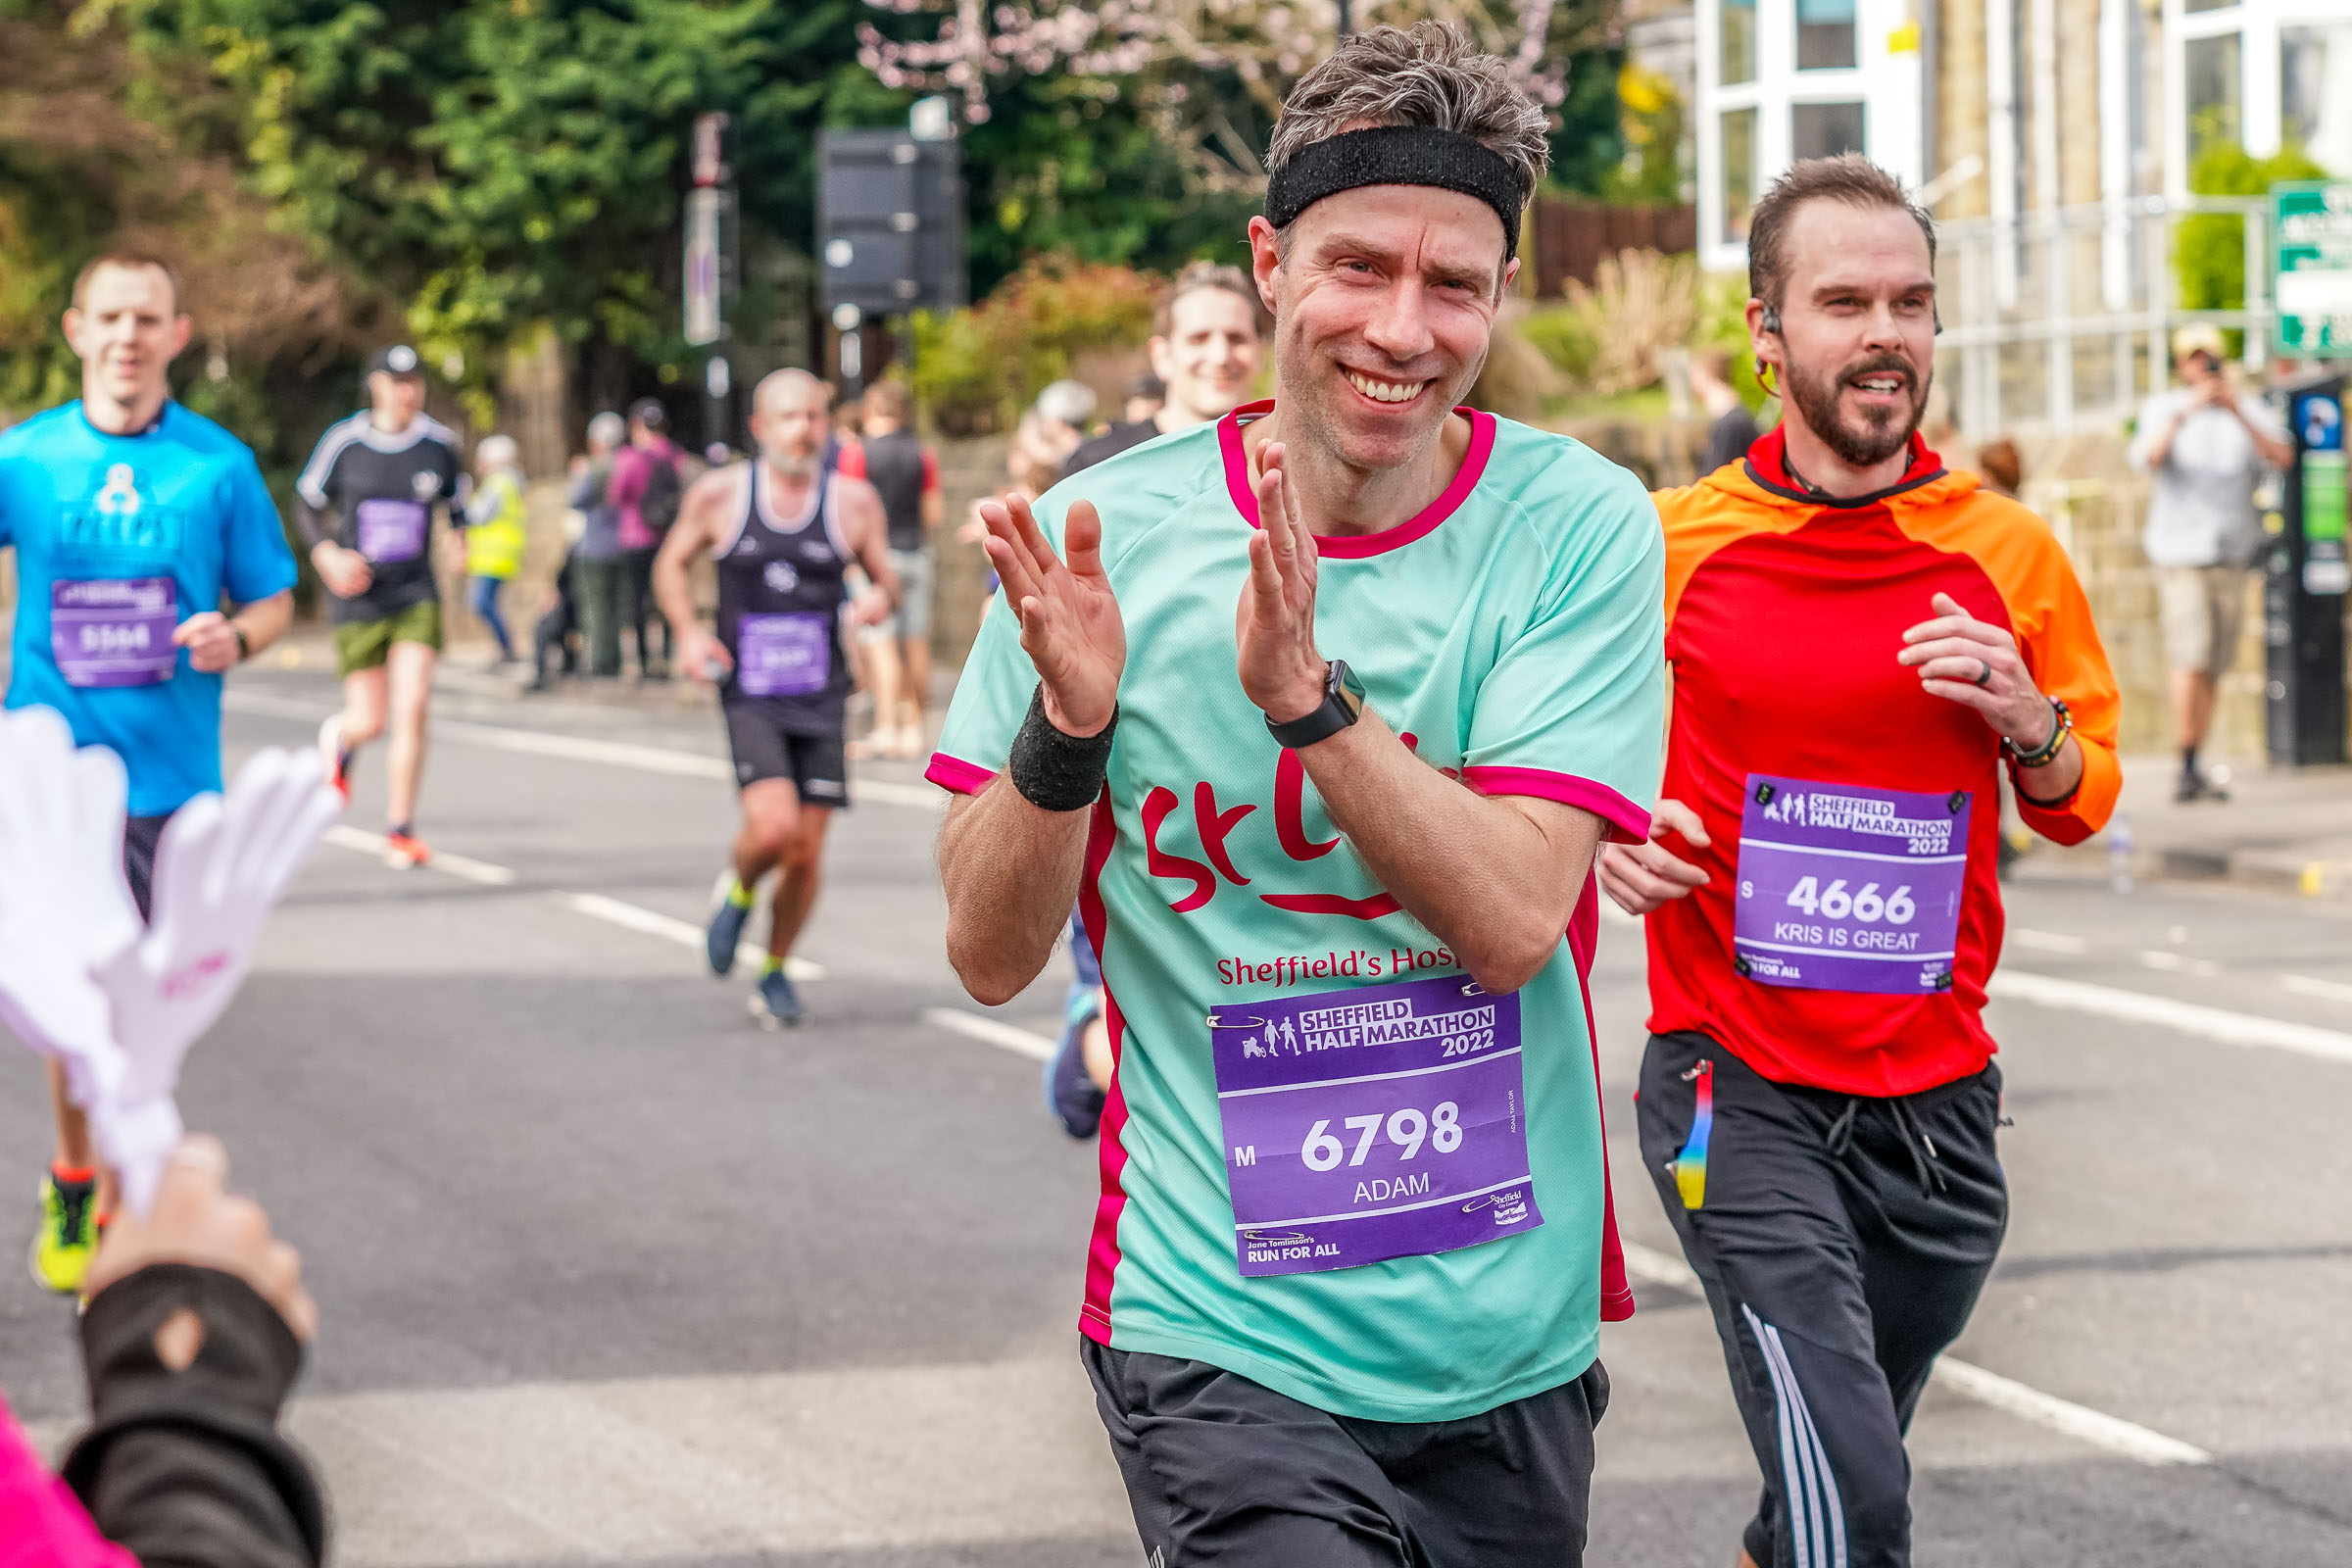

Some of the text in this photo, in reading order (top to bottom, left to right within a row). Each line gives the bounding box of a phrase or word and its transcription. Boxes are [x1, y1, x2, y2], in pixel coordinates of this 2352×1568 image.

[1812, 796, 1891, 816] SHEFFIELD
[1810, 811, 1950, 835] HALF MARATHON
[1907, 838, 1949, 856] 2022
[1740, 880, 1753, 899] S
[1787, 875, 1916, 925] 4666
[1774, 921, 1921, 951] KRIS IS GREAT
[1216, 950, 1382, 988] Sheffield's
[1302, 1001, 1408, 1031] SHEFFIELD
[1305, 1007, 1493, 1053] HALF MARATHON
[1441, 1029, 1494, 1057] 2022
[1301, 1101, 1463, 1172] 6798
[1234, 1145, 1257, 1167] M
[1353, 1171, 1431, 1203] ADAM
[1248, 1236, 1315, 1250] Jane Tomlinson's
[1248, 1243, 1341, 1263] RUN FOR ALL
